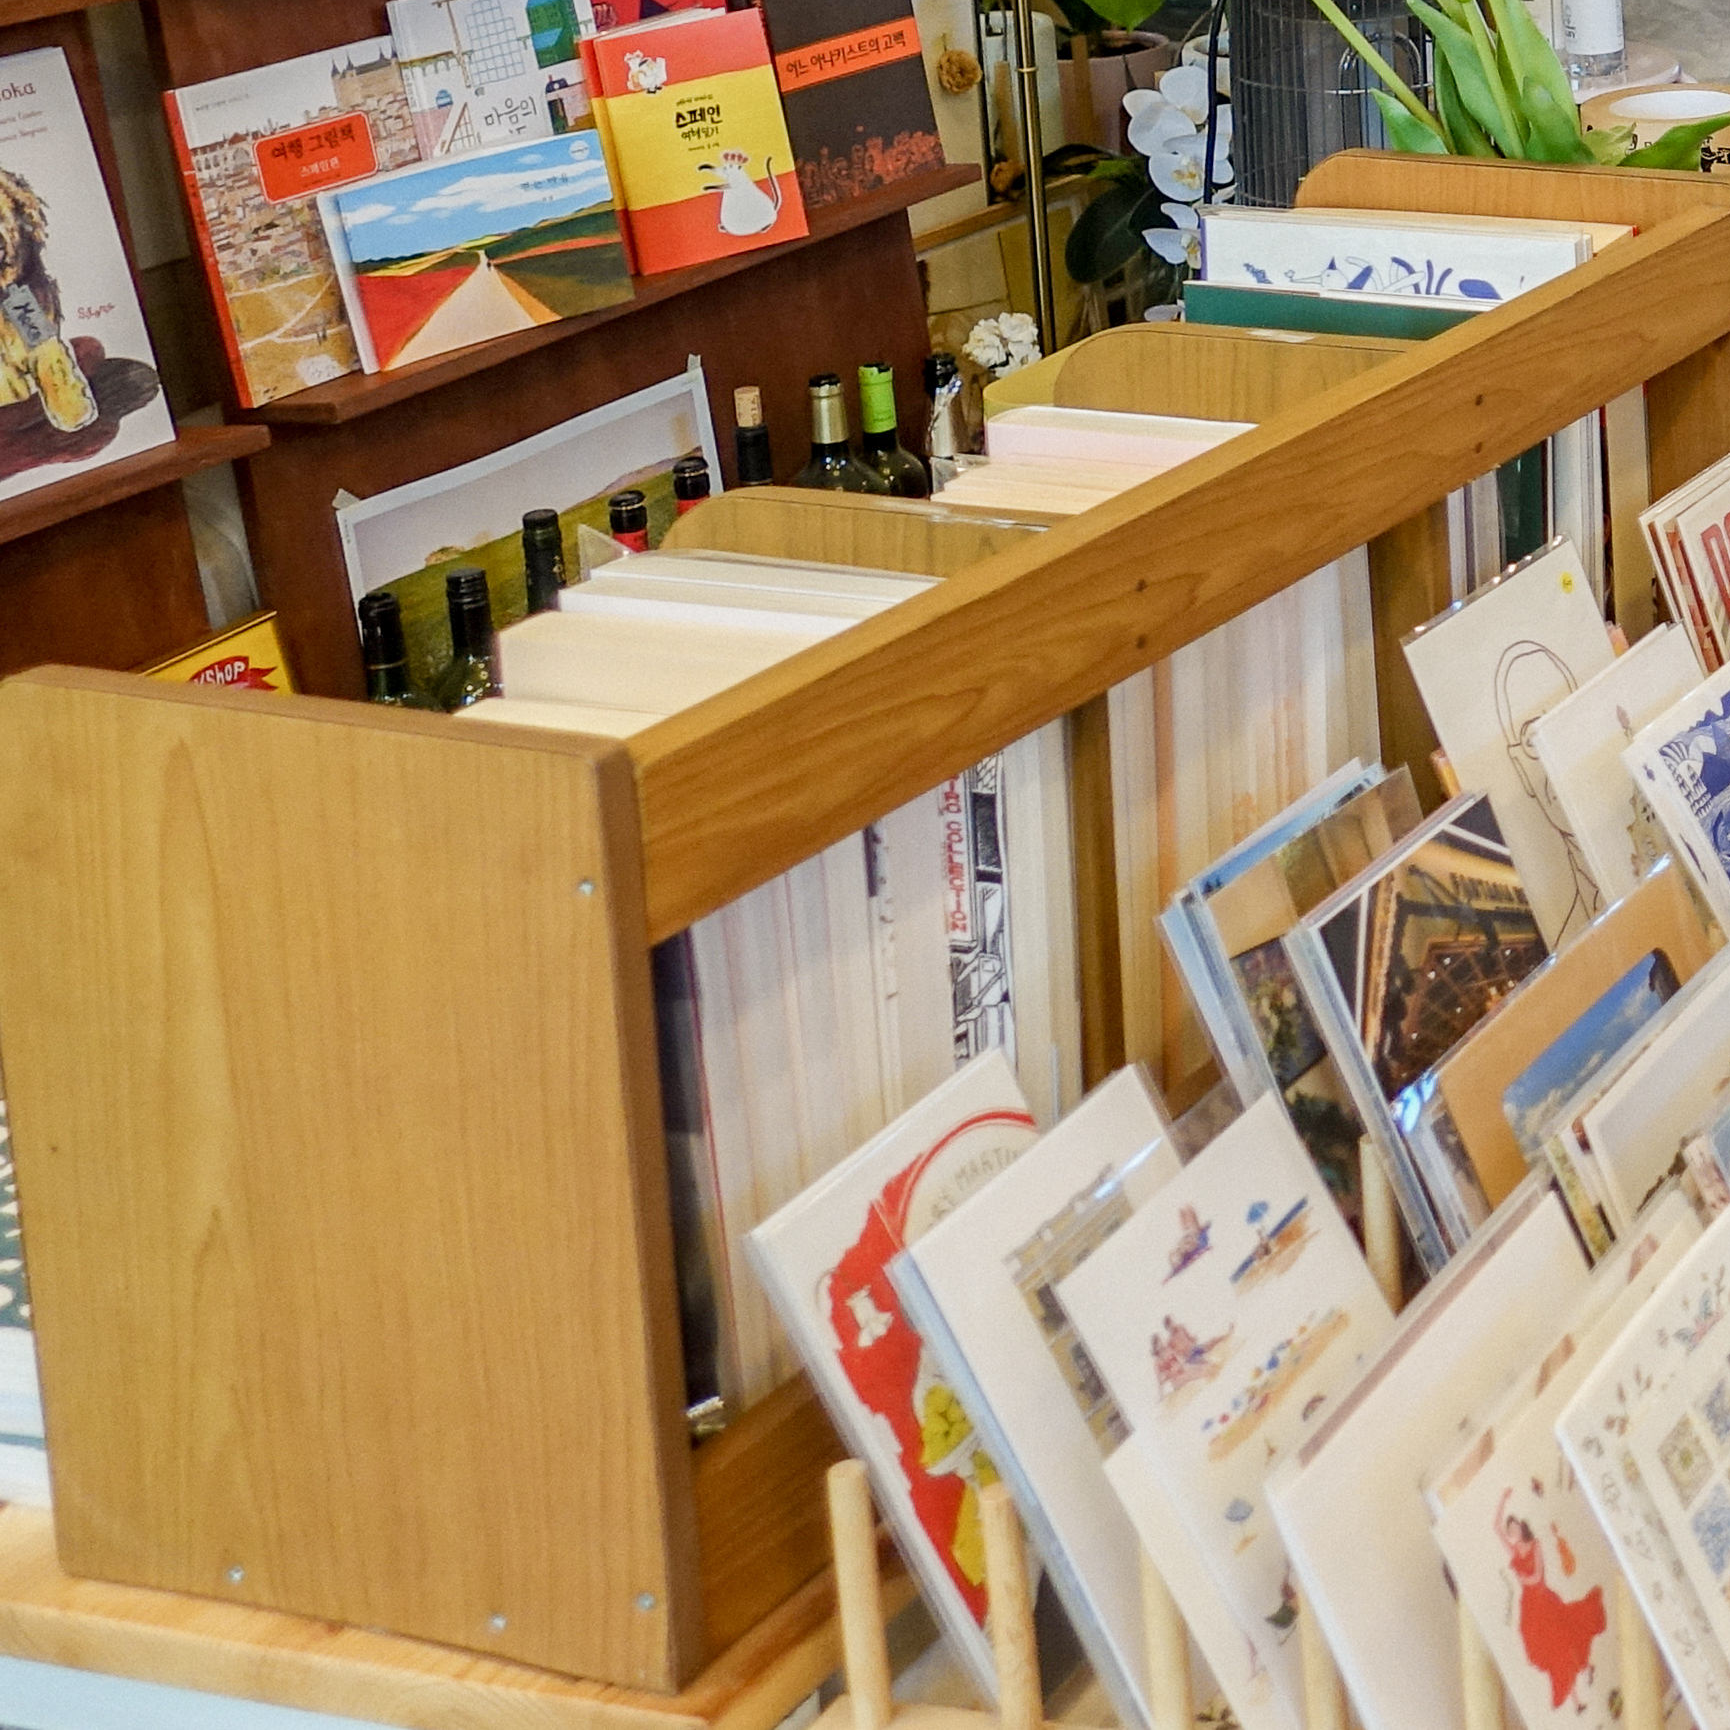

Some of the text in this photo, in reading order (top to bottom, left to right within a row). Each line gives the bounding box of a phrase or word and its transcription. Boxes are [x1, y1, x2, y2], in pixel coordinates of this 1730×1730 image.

[785, 29, 908, 80] 어느 아나키스트의 고백
[0, 80, 36, 102] oka
[483, 96, 538, 127] 마음의
[675, 102, 724, 129] 스페인
[271, 121, 356, 160] 여행 그림책
